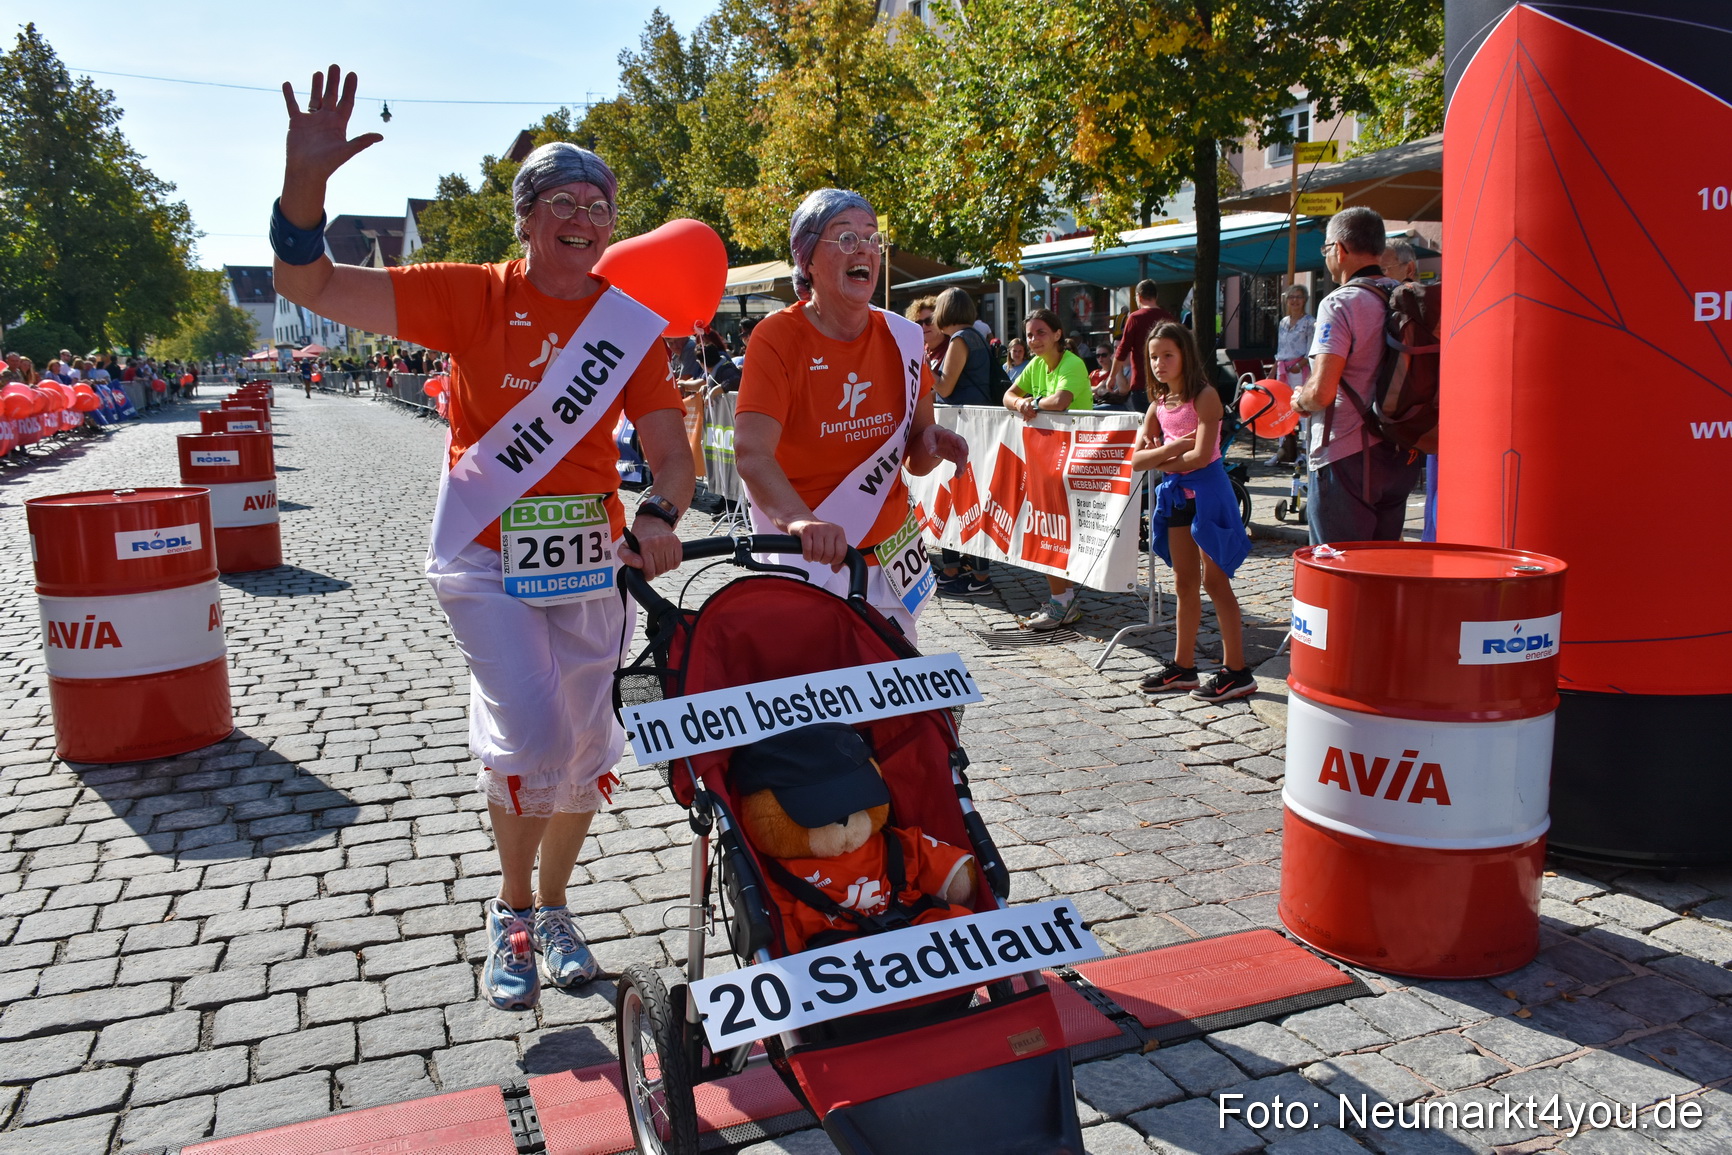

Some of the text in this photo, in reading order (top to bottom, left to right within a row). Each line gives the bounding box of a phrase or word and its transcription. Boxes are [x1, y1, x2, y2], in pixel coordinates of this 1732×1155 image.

[1697, 186, 1732, 211] 10
[501, 373, 538, 391] funr
[495, 337, 626, 474] wir auch
[820, 412, 893, 437] funrunners
[845, 421, 900, 442] neumark
[858, 447, 900, 496] wir
[1072, 479, 1112, 491] HEBEBÄNDER
[511, 500, 603, 527] BOCK
[984, 490, 1013, 535] Braun
[1077, 498, 1091, 508] Braun
[958, 503, 981, 532] Braun
[1025, 500, 1067, 541] Braun
[882, 512, 920, 560] BOC
[517, 531, 603, 570] 2613
[892, 536, 930, 589] 206
[516, 572, 606, 594] HILDEGARD
[917, 572, 936, 596] LUIS
[1525, 648, 1553, 660] energie
[632, 666, 971, 754] in den besten Jahren
[813, 877, 832, 889] ima
